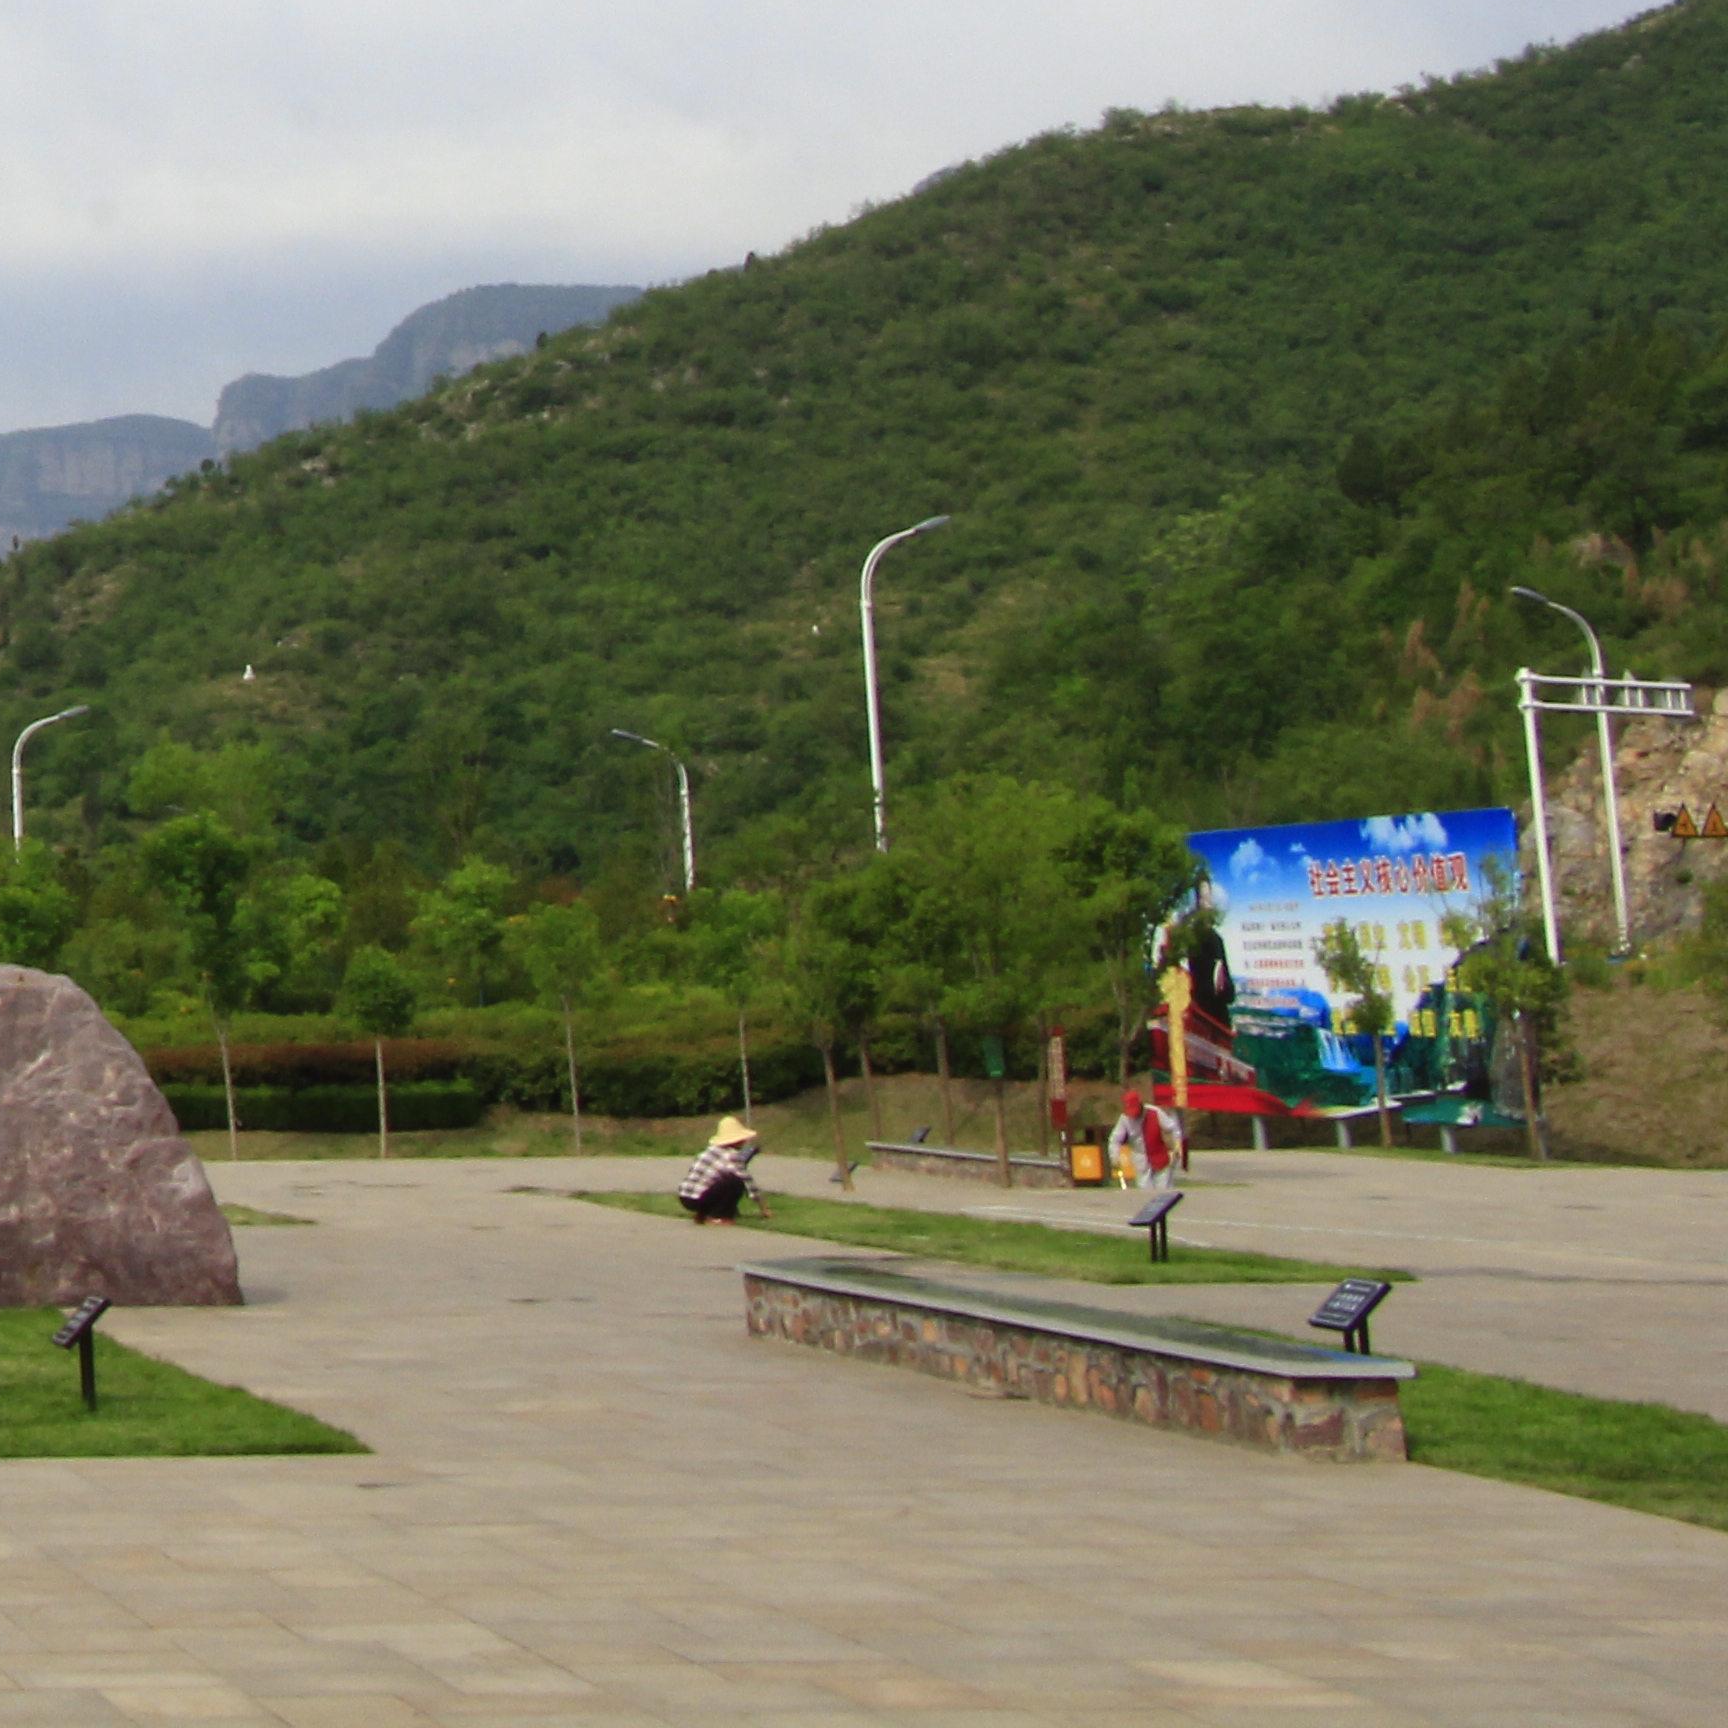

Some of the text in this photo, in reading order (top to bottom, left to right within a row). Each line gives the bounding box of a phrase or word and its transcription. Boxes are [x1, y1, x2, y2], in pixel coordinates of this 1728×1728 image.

[1308, 852, 1469, 898] 社会主义核心价值观
